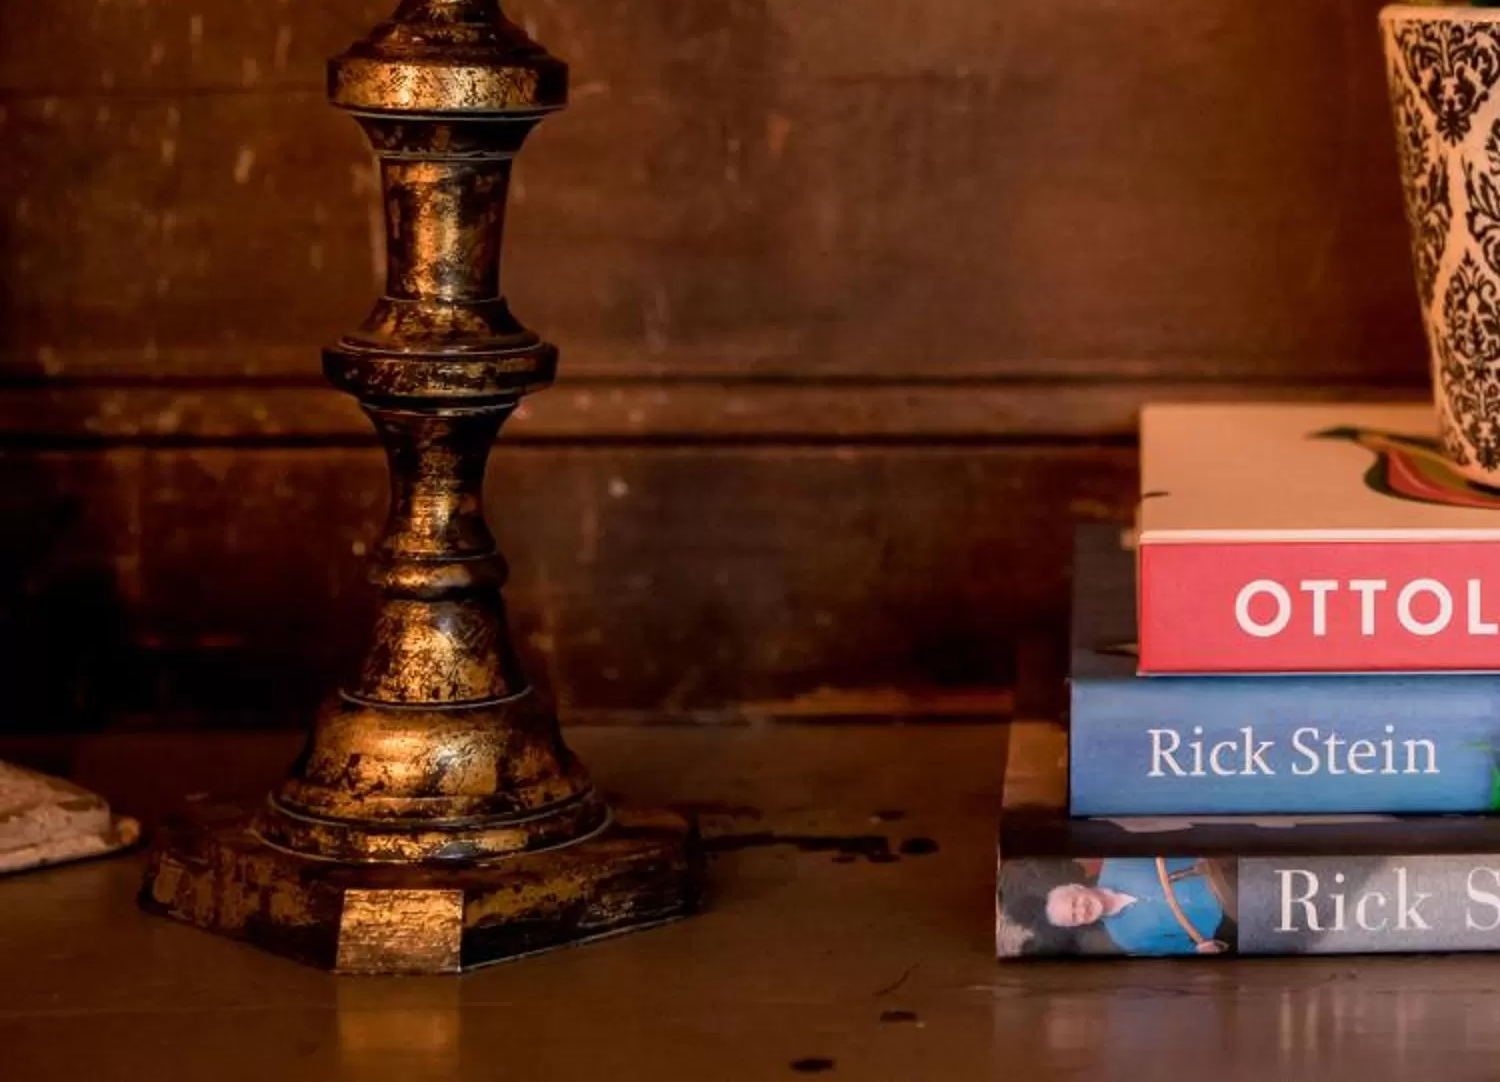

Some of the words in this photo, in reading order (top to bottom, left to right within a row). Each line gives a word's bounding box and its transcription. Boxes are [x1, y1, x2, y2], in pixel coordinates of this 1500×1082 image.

[1147, 724, 1276, 778] Rick
[1291, 724, 1441, 776] Stein
[1273, 867, 1433, 932] Rick
